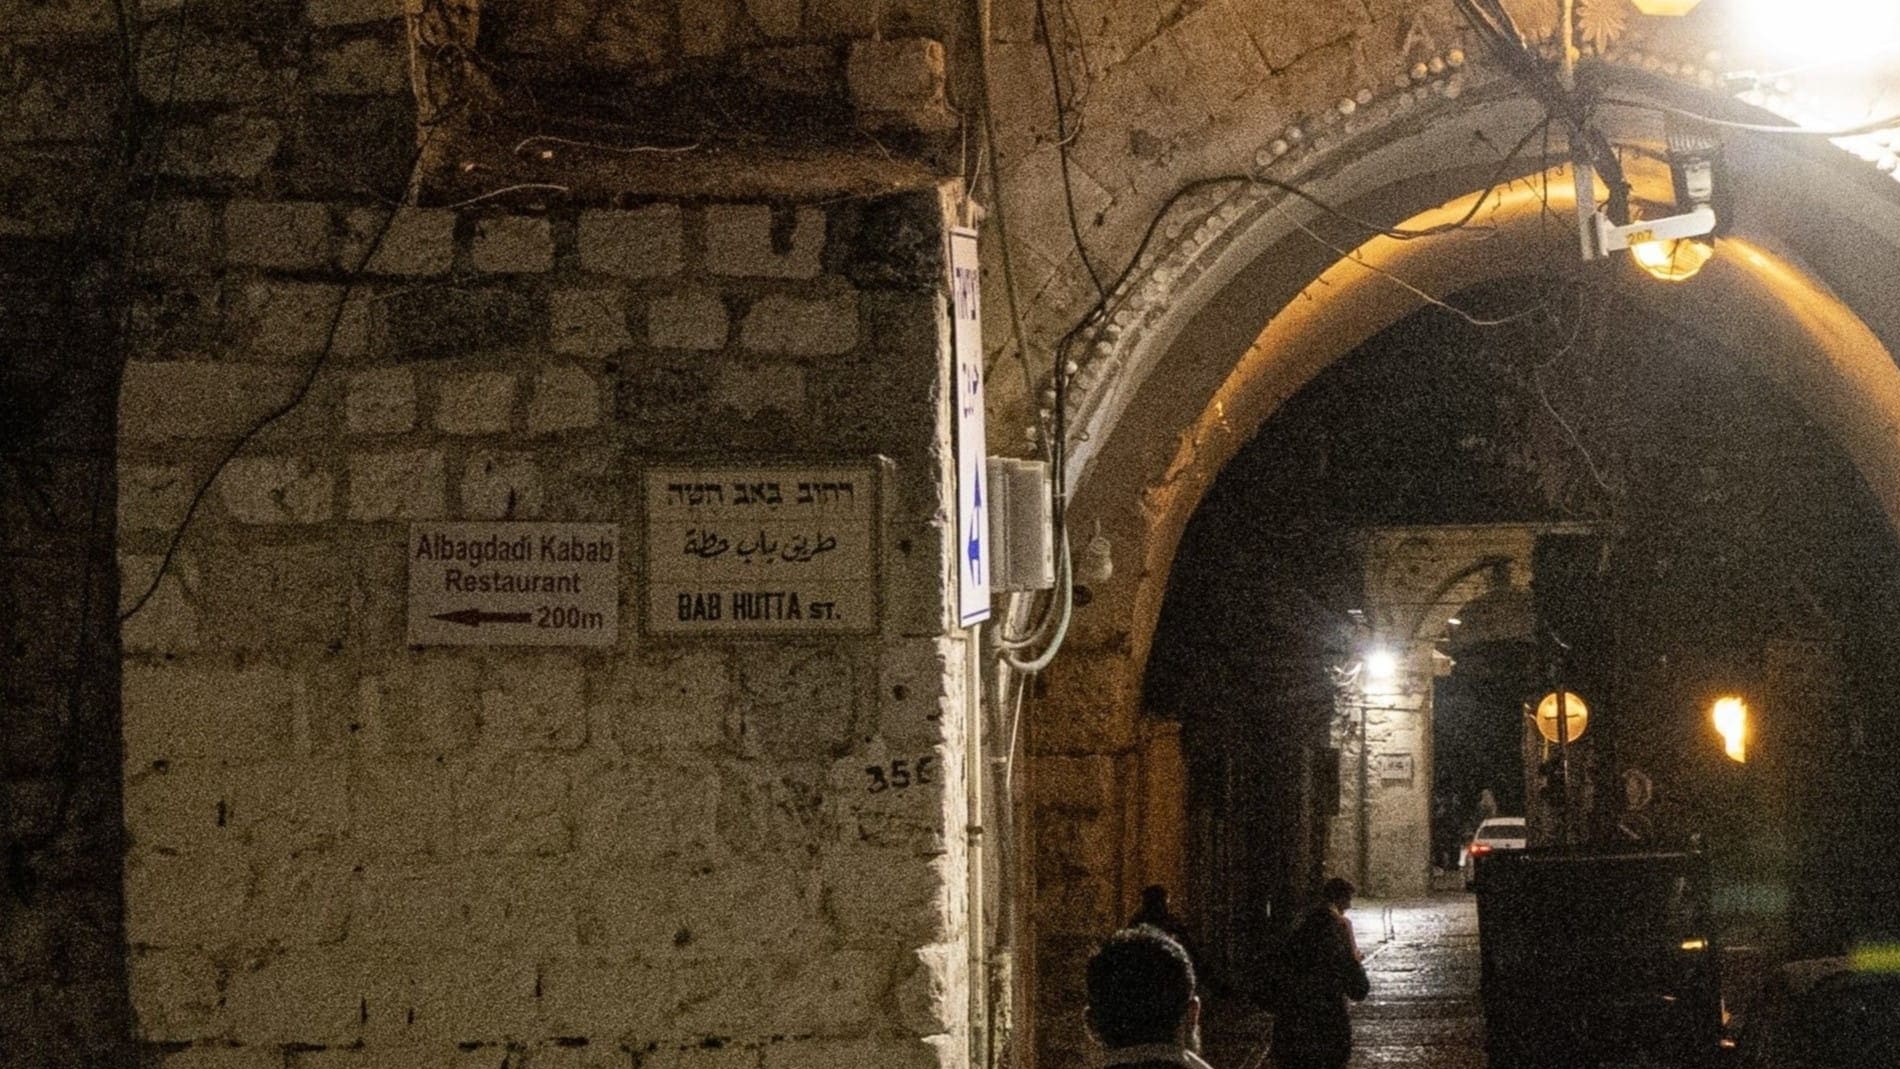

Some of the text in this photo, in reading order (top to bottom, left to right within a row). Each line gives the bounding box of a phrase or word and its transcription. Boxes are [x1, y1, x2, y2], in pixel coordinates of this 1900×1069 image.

[797, 482, 853, 505] רחוב
[416, 534, 614, 567] Albagdadi Kabab
[684, 528, 837, 563] طريق باب حطة
[445, 569, 581, 594] Restaurant
[537, 605, 603, 629] 200m
[678, 592, 841, 621] BAB HUTTA ST.
